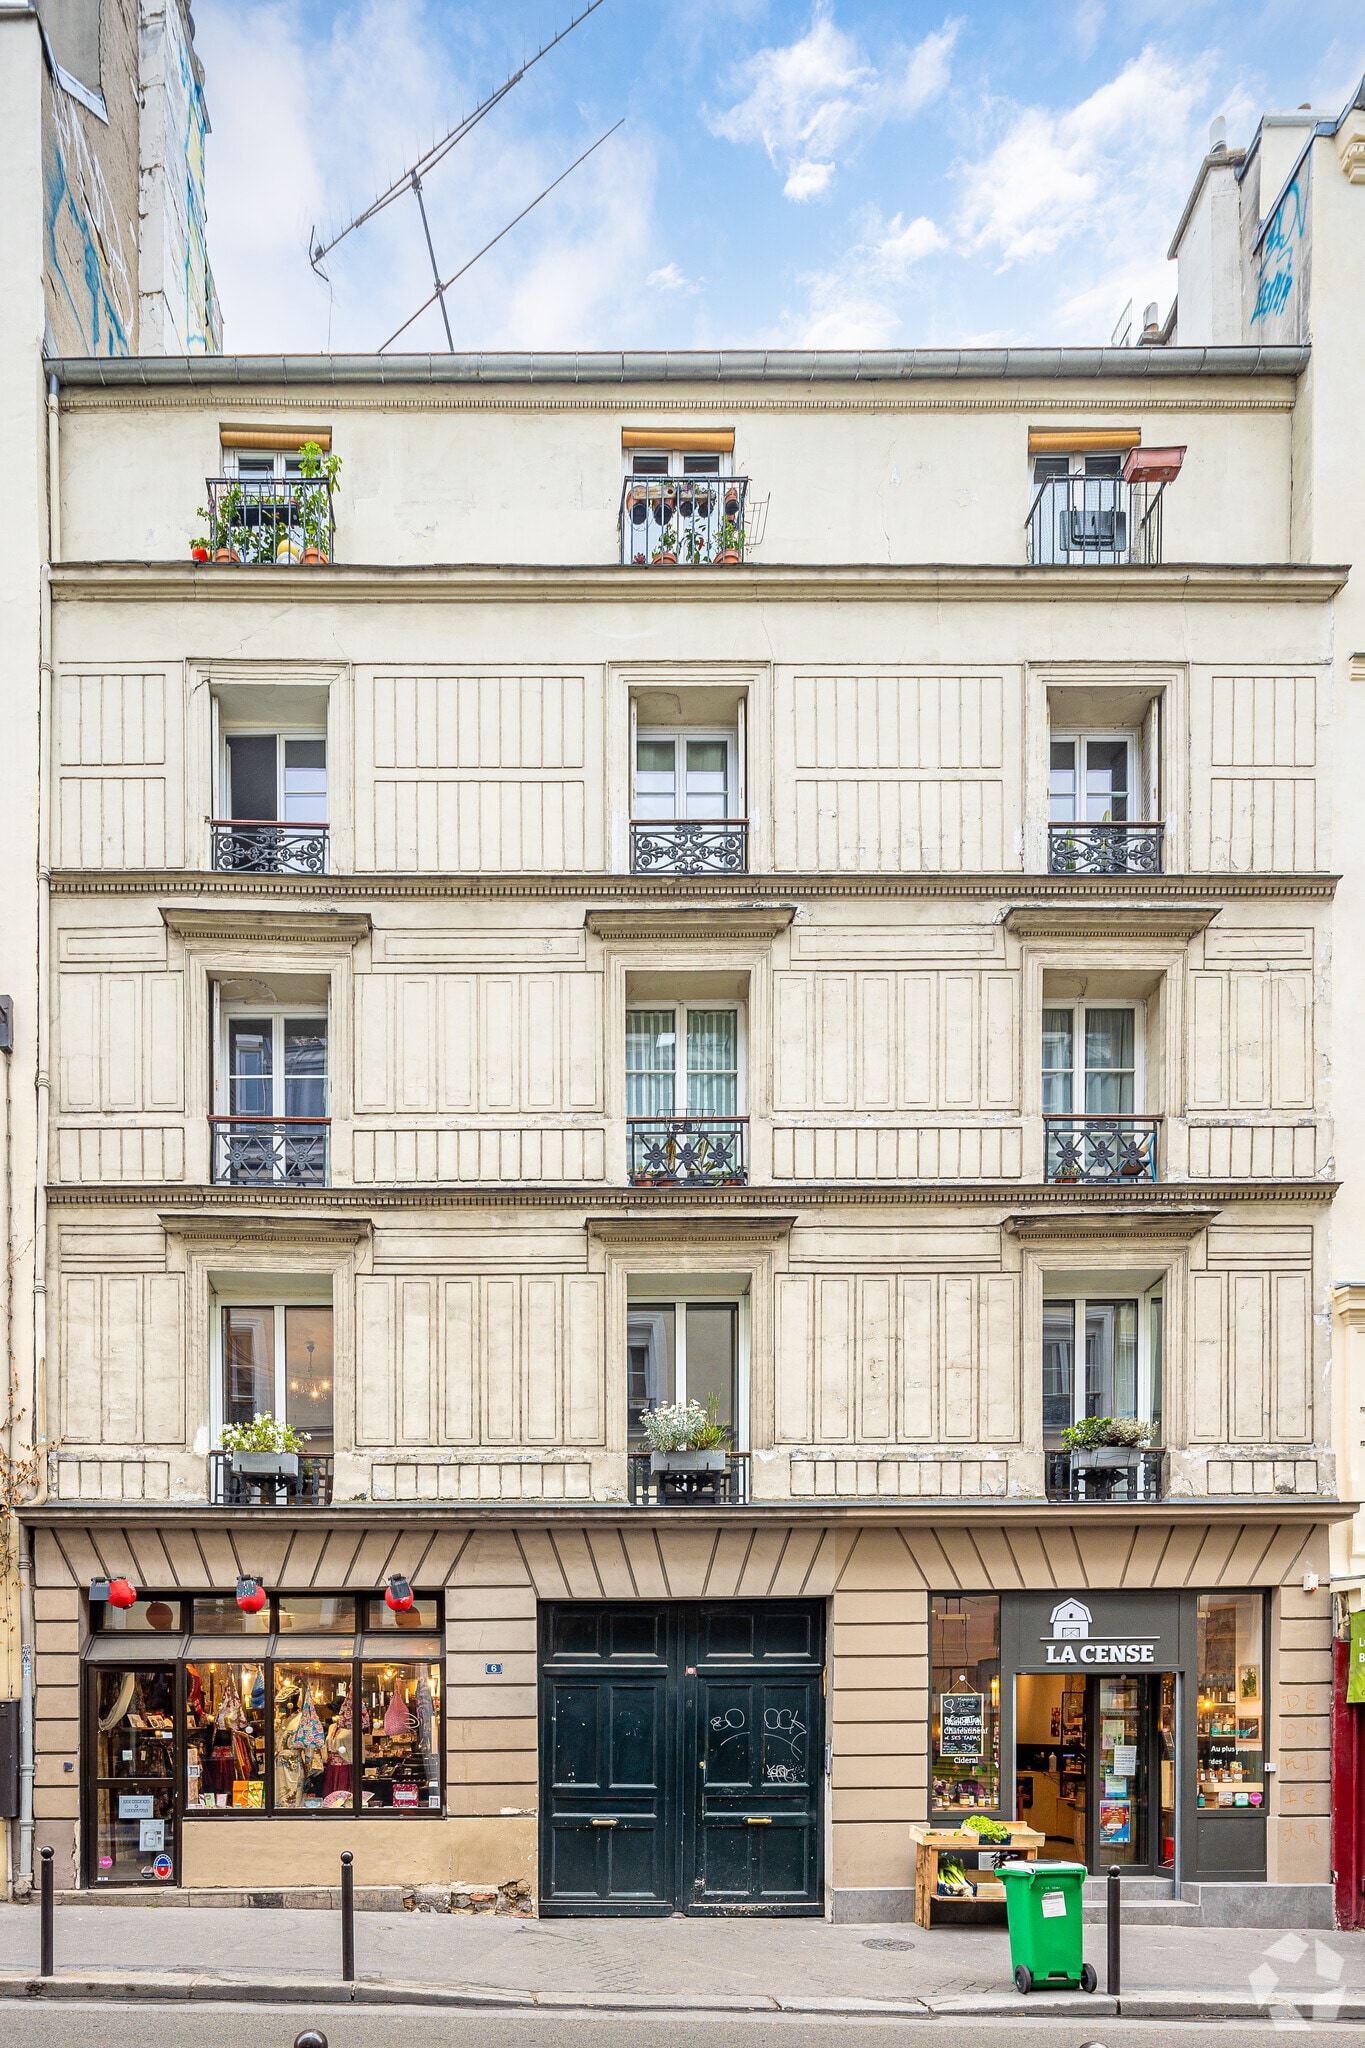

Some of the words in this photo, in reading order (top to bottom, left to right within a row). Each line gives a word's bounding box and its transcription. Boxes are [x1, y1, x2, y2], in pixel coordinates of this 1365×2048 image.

[1046, 1645, 1077, 1663] LA
[1080, 1645, 1154, 1663] CENSE
[490, 1664, 497, 1673] 6
[1222, 1745, 1235, 1753] plus
[953, 1756, 979, 1764] Cideral
